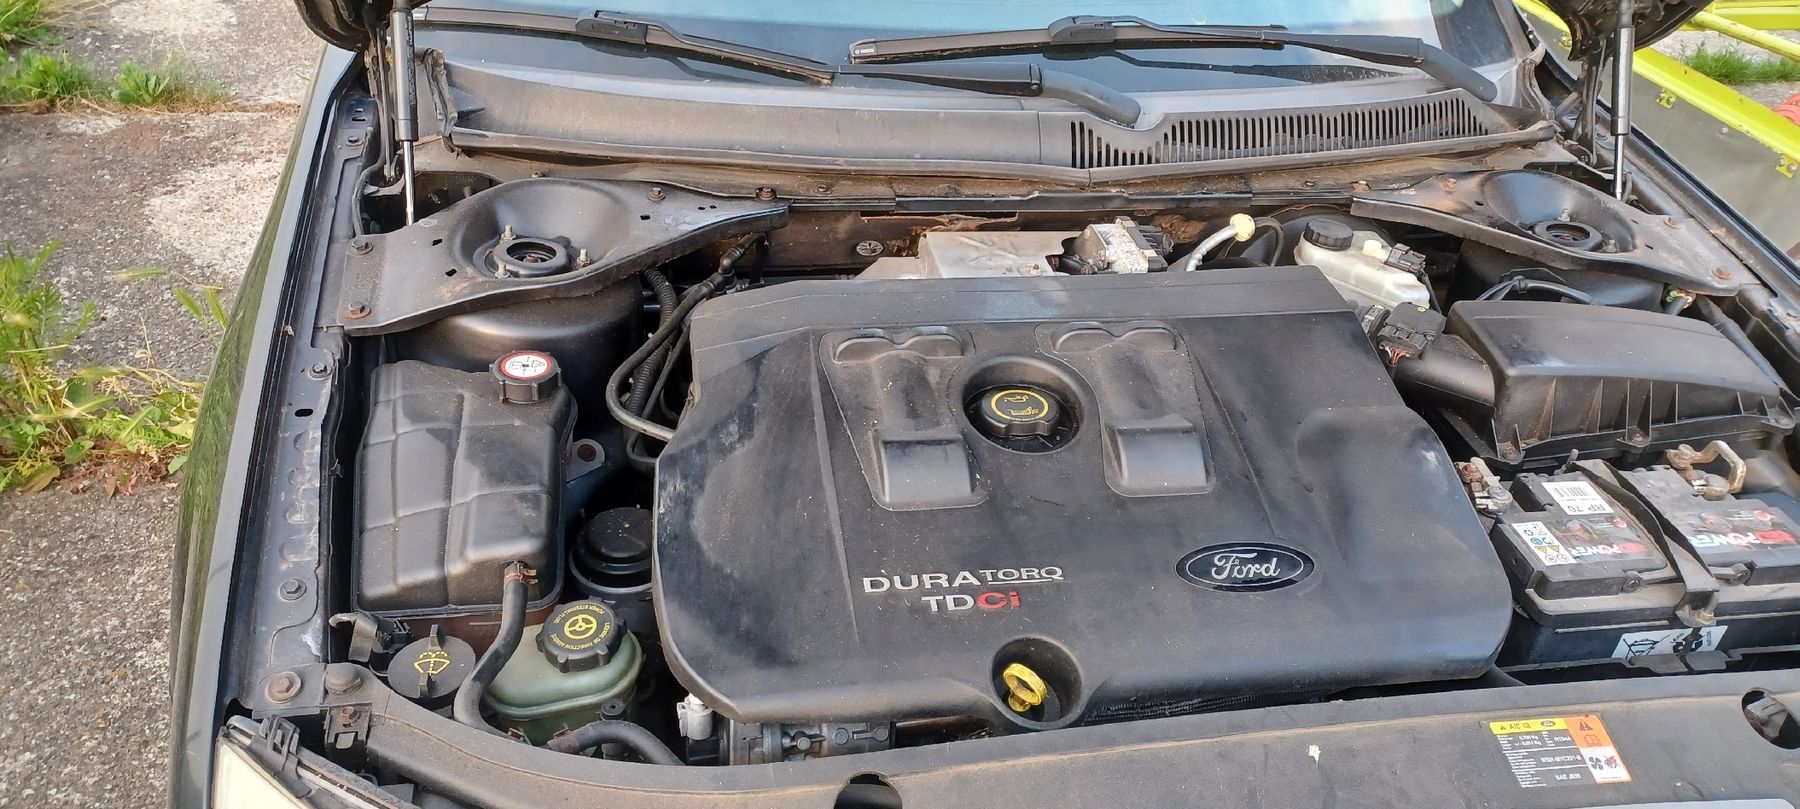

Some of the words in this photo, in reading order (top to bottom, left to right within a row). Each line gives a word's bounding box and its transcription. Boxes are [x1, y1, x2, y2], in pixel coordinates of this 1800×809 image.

[1567, 505, 1584, 513] 70
[1210, 552, 1281, 580] Ford
[863, 566, 1065, 593] DURATORQ
[922, 590, 1021, 612] TDCi
